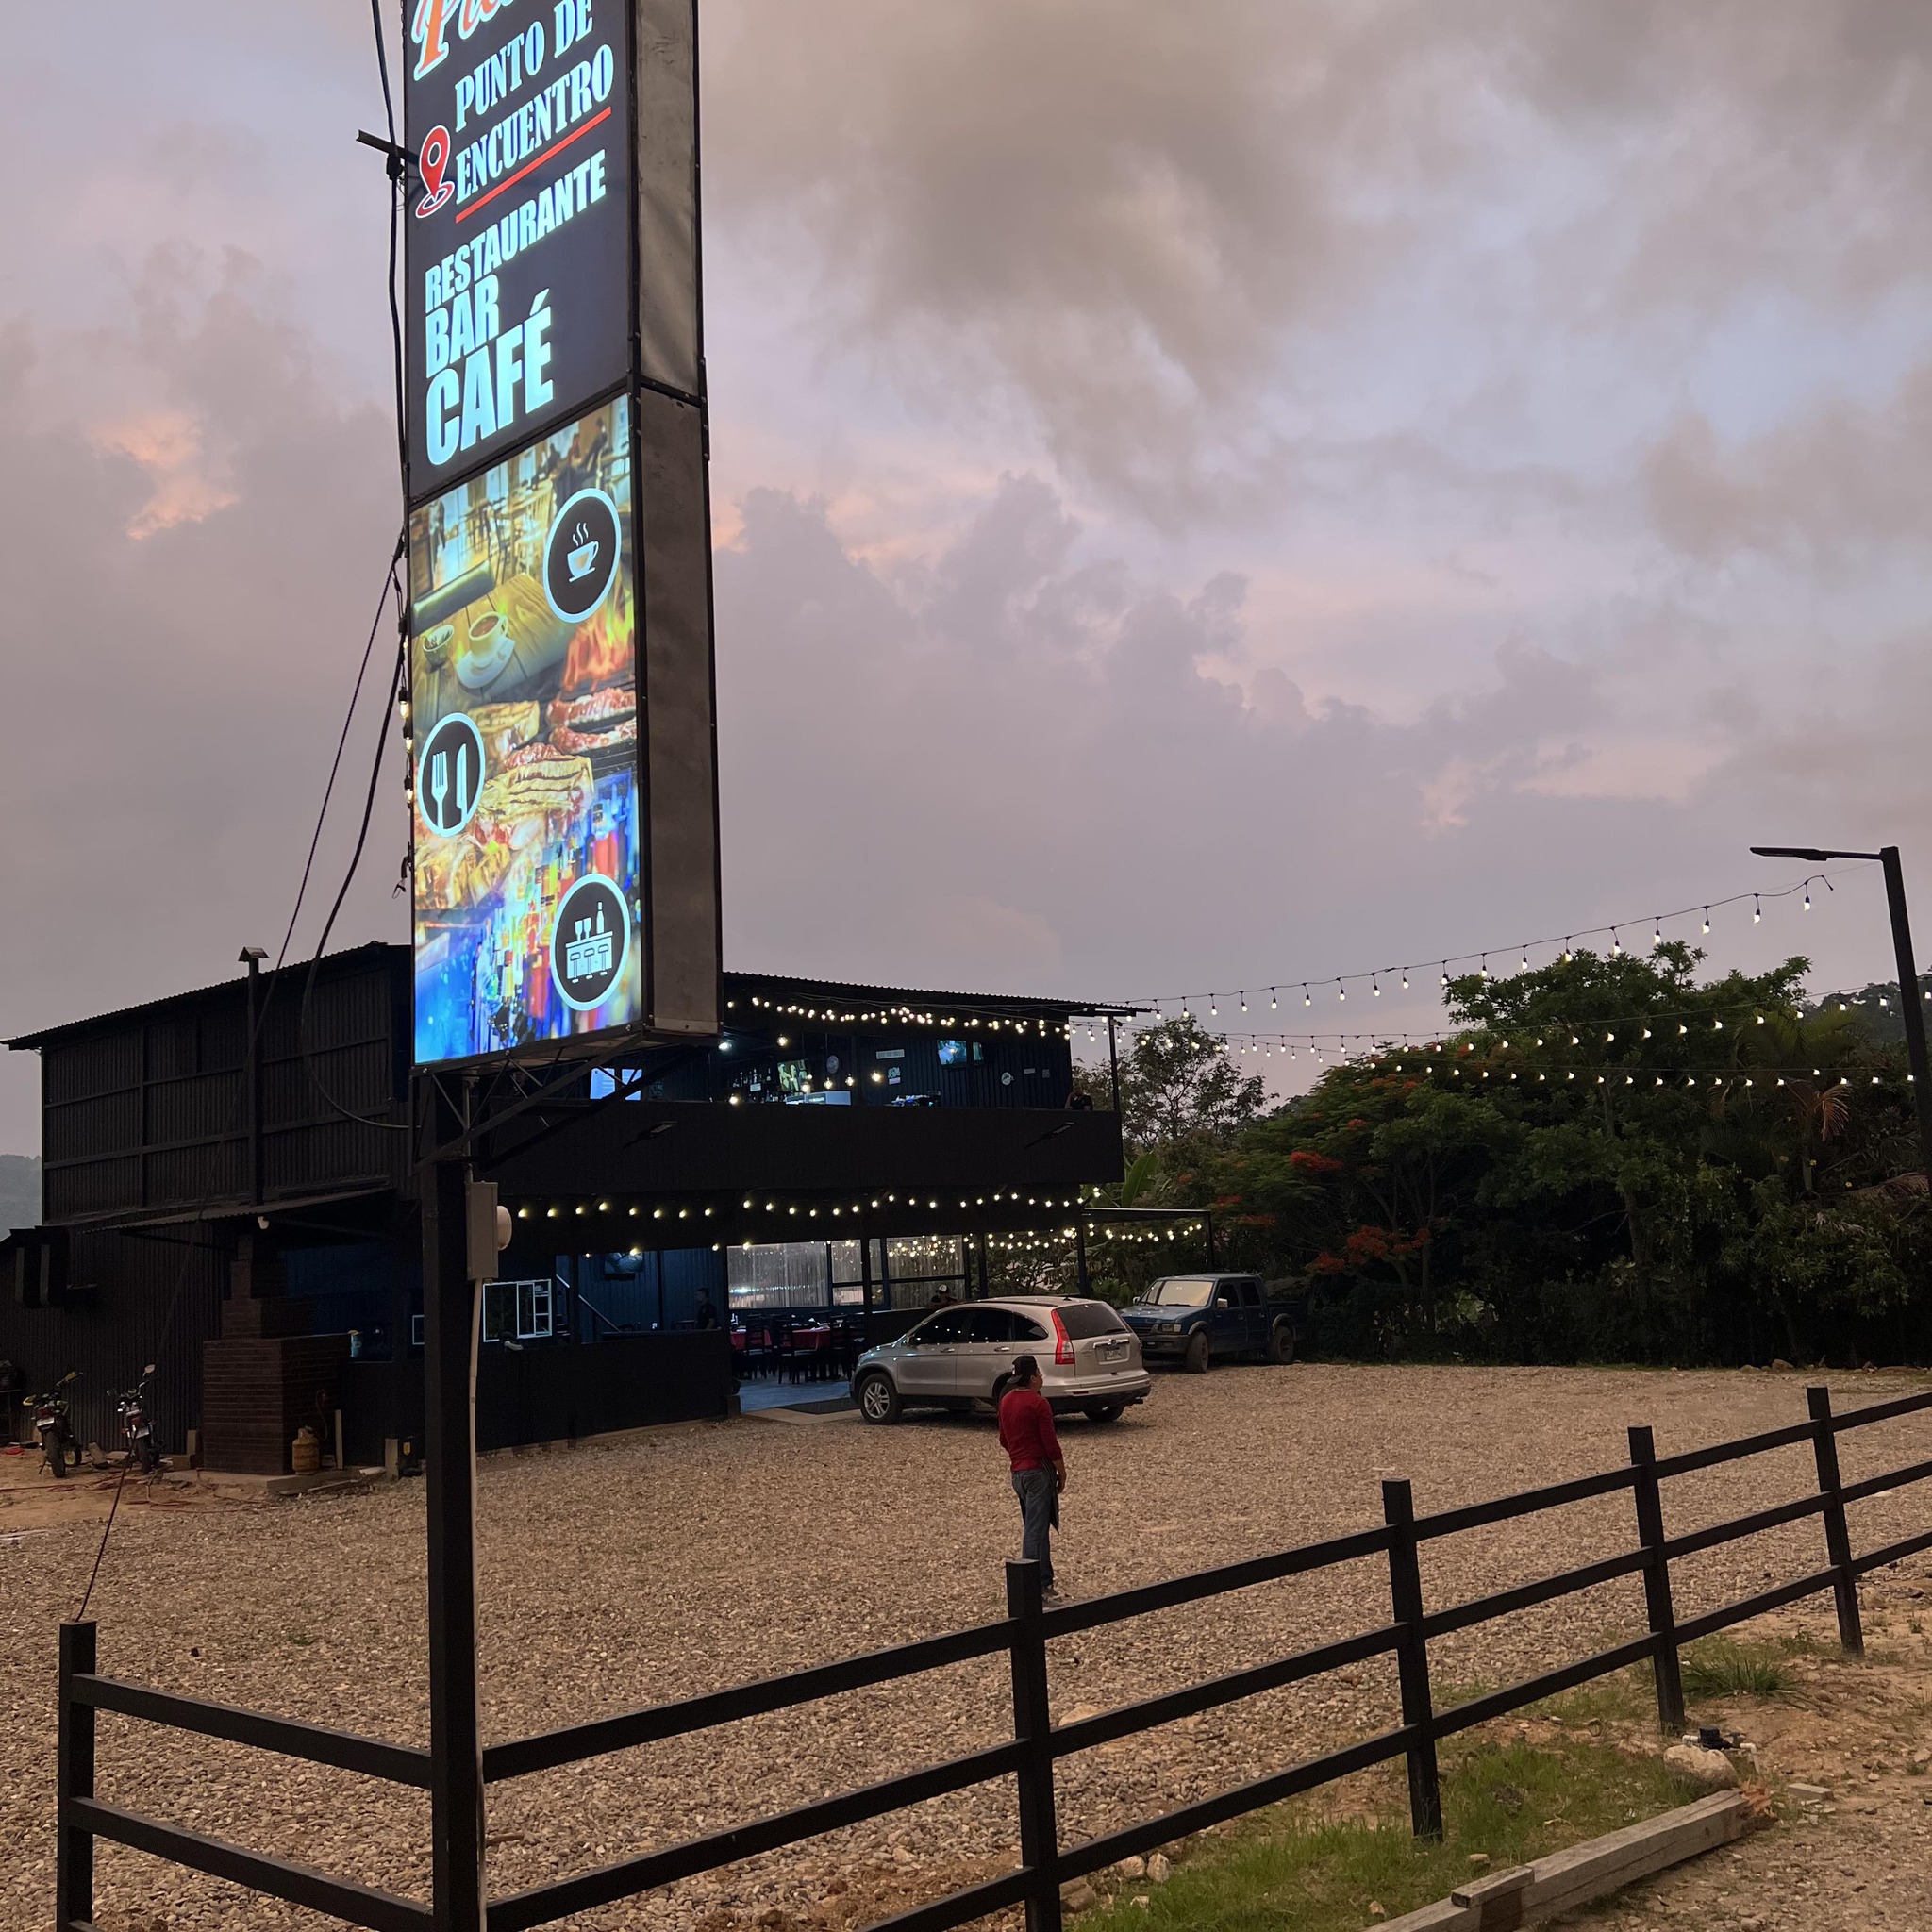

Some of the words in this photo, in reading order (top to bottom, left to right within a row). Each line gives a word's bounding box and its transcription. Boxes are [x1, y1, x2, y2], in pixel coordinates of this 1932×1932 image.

[455, 44, 614, 205] ENCUENTRO
[456, 21, 545, 133] PUNTO
[554, 0, 593, 58] DE
[425, 149, 607, 313] RESTAURANTE
[425, 274, 500, 379] BAR
[425, 288, 554, 466] CAFÉ
